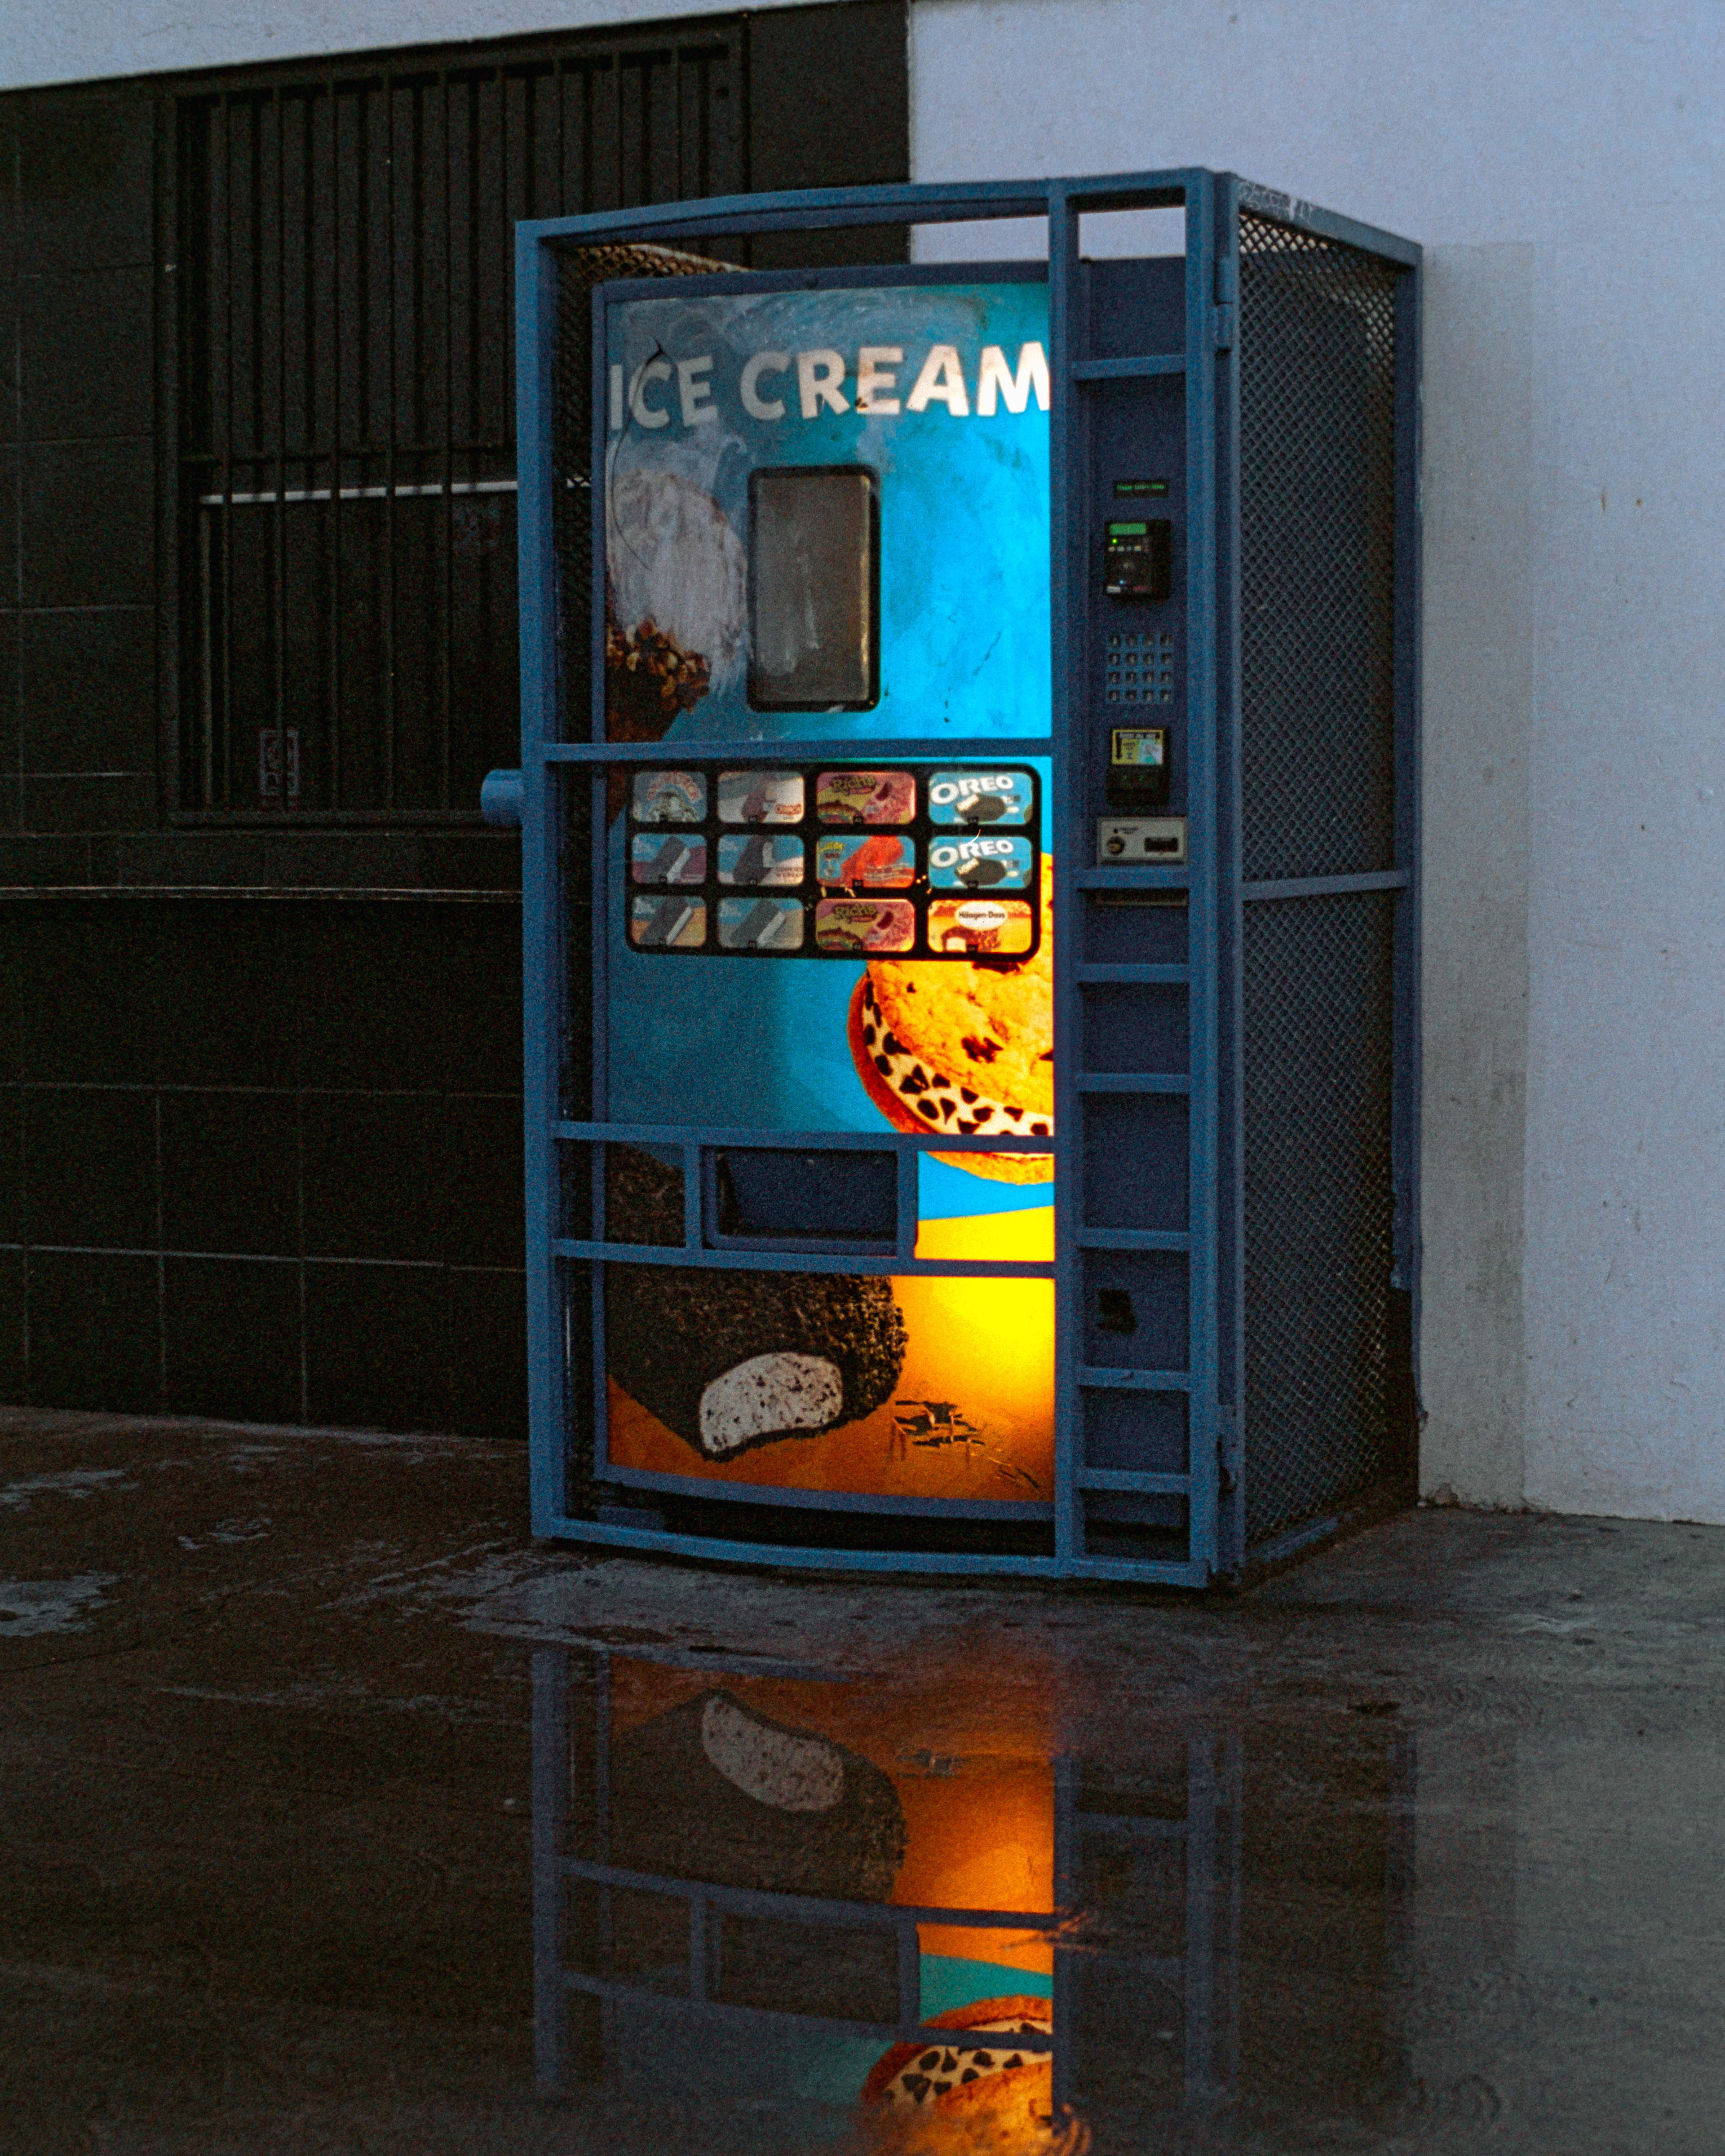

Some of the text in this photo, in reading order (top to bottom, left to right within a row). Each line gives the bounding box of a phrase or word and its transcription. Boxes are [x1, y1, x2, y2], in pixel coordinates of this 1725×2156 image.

[609, 341, 1050, 430] ICE CREAM
[930, 775, 1014, 804] OREO
[930, 840, 1014, 868] OREO
